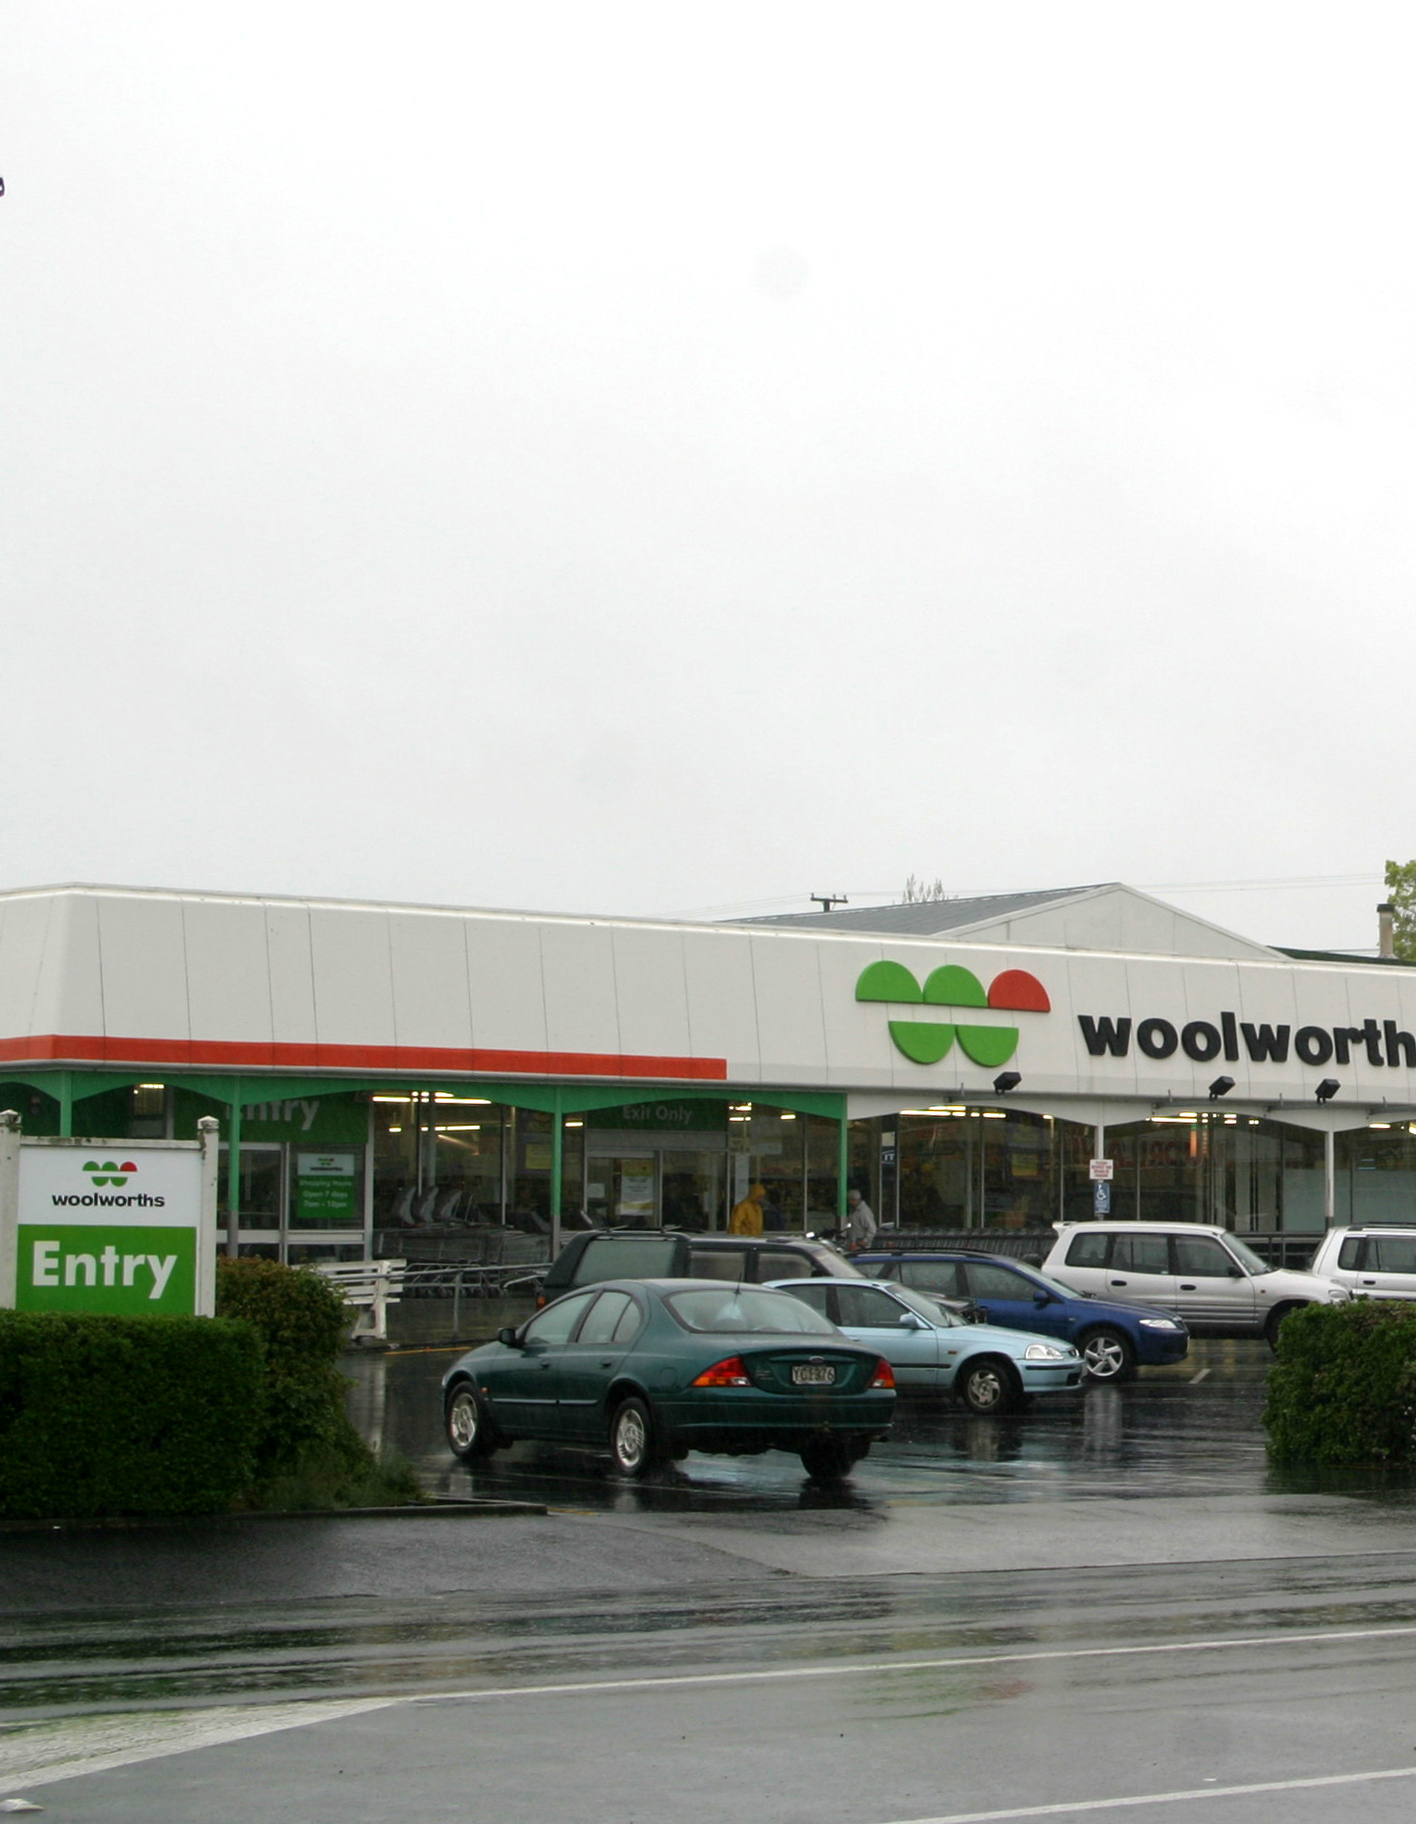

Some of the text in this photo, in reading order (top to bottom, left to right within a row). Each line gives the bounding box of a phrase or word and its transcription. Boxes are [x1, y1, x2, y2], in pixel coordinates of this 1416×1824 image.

[225, 1100, 320, 1130] ntry
[623, 1105, 692, 1125] Exit Only
[52, 1192, 165, 1207] woolworths
[33, 1240, 178, 1299] Entry
